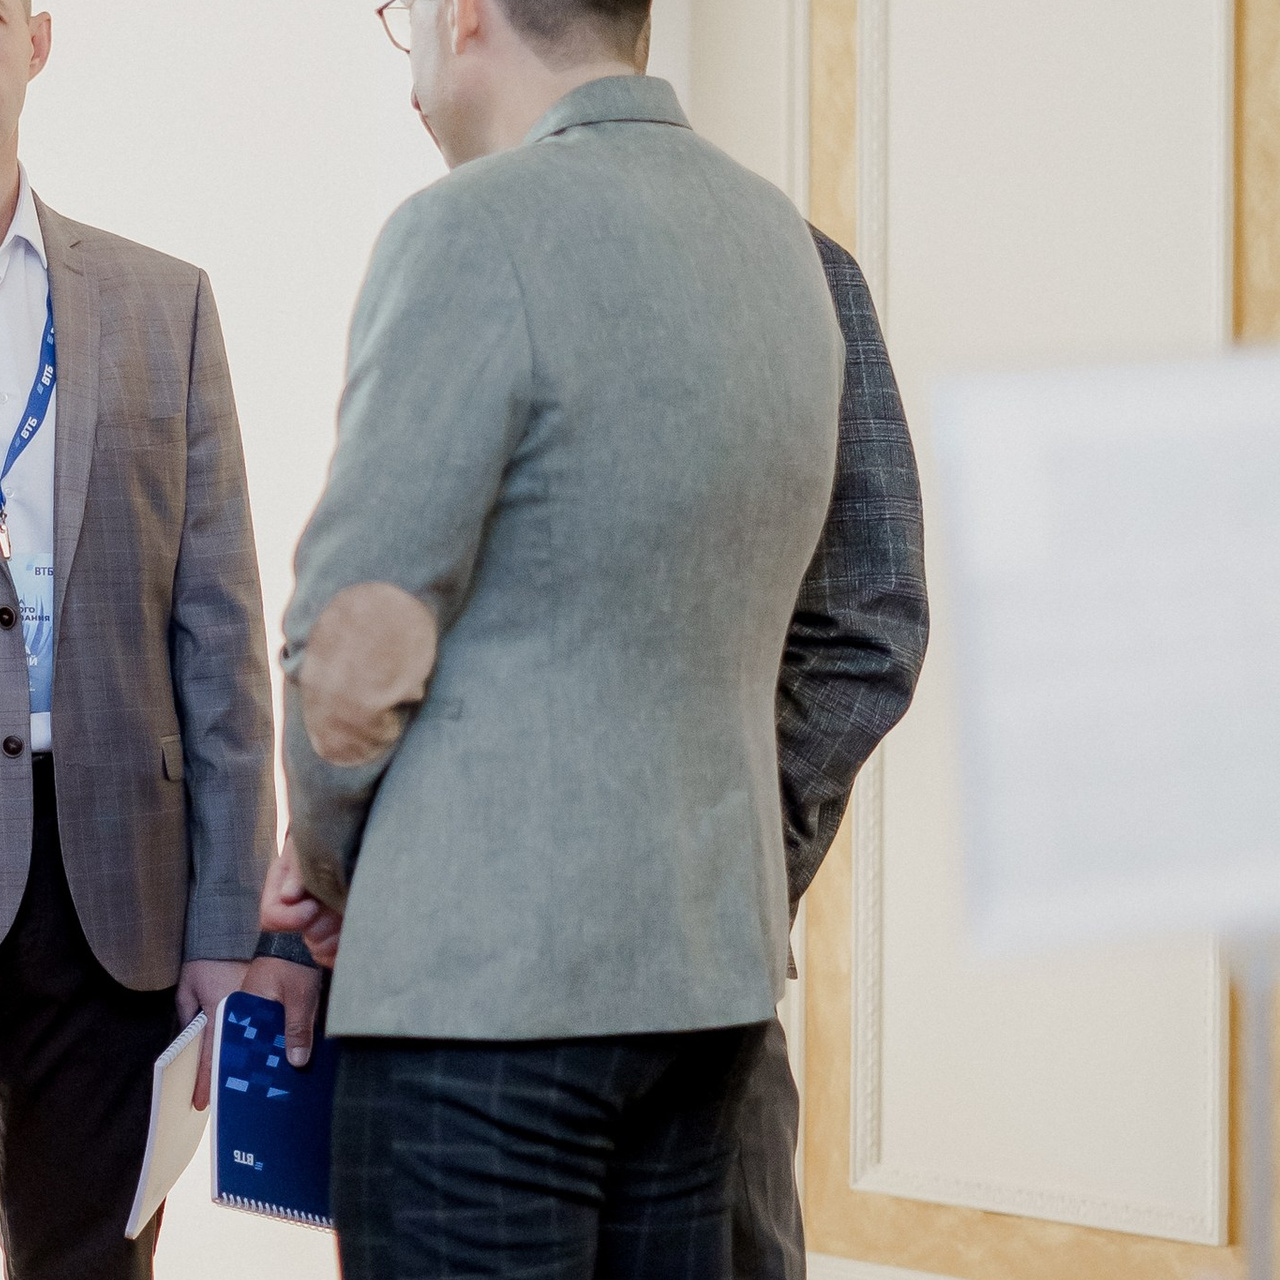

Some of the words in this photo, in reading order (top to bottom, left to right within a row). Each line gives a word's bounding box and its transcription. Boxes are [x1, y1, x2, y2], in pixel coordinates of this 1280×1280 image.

[41, 364, 54, 387] ВТБ
[20, 416, 39, 440] ВТБ
[34, 566, 54, 576] ВТБ
[233, 1150, 254, 1166] ВТБ
